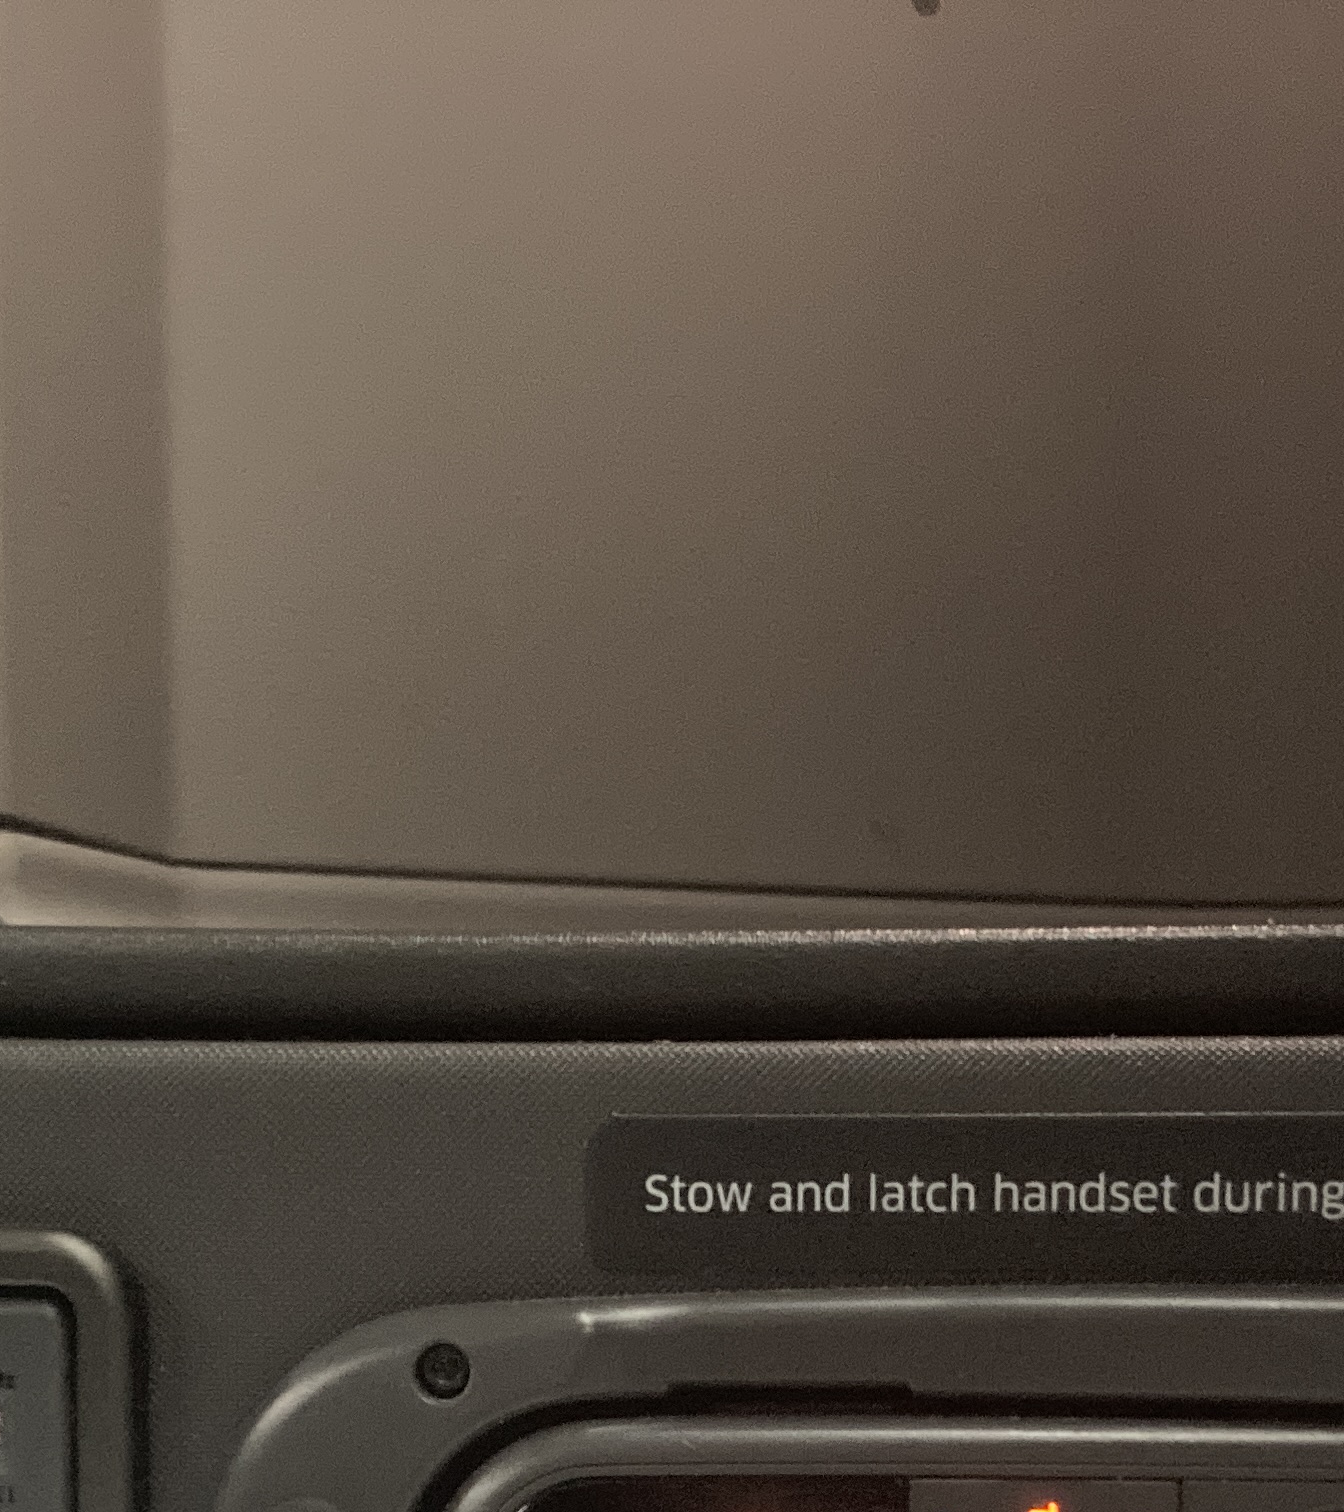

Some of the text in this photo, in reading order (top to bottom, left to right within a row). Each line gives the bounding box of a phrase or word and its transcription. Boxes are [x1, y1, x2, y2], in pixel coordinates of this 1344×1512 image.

[644, 1174, 753, 1213] Stow
[768, 1174, 851, 1213] and
[869, 1174, 977, 1213] latch
[994, 1173, 1176, 1213] handset
